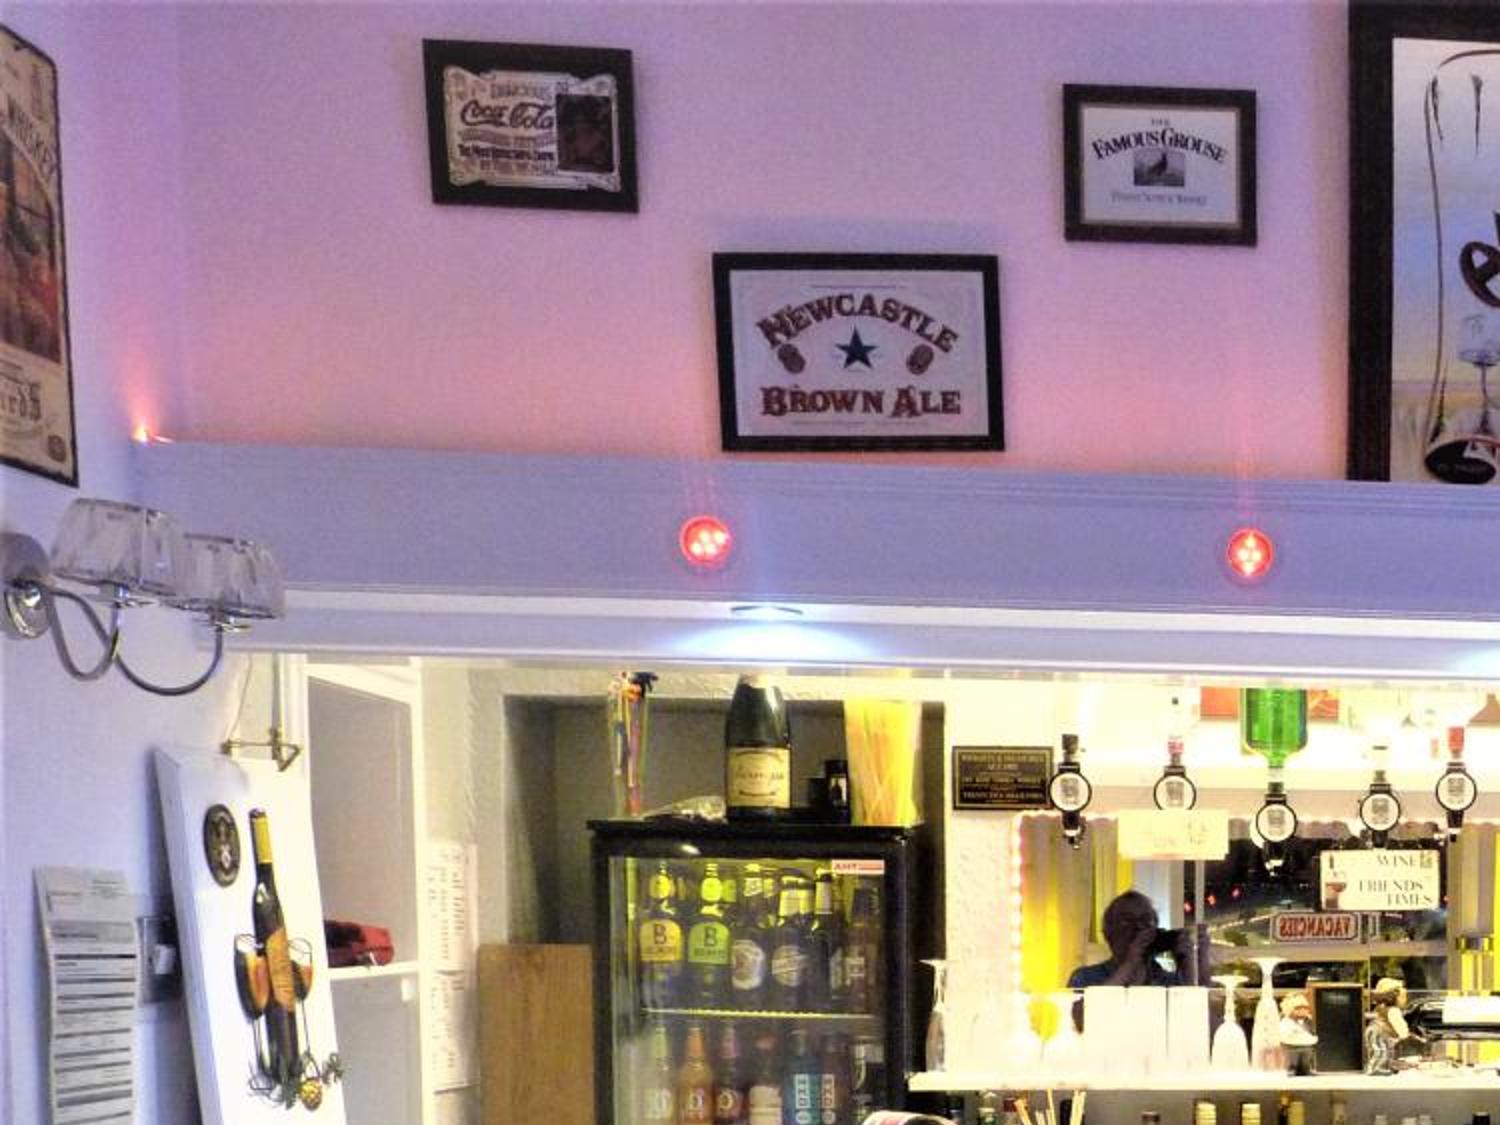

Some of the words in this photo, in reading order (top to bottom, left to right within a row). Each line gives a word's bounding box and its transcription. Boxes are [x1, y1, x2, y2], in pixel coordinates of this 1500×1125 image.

[1091, 130, 1160, 160] FAMOUS
[1161, 127, 1227, 164] GROUSE
[757, 293, 959, 355] NEWCASTLE
[761, 384, 885, 417] BROWN
[889, 384, 961, 418] ALE
